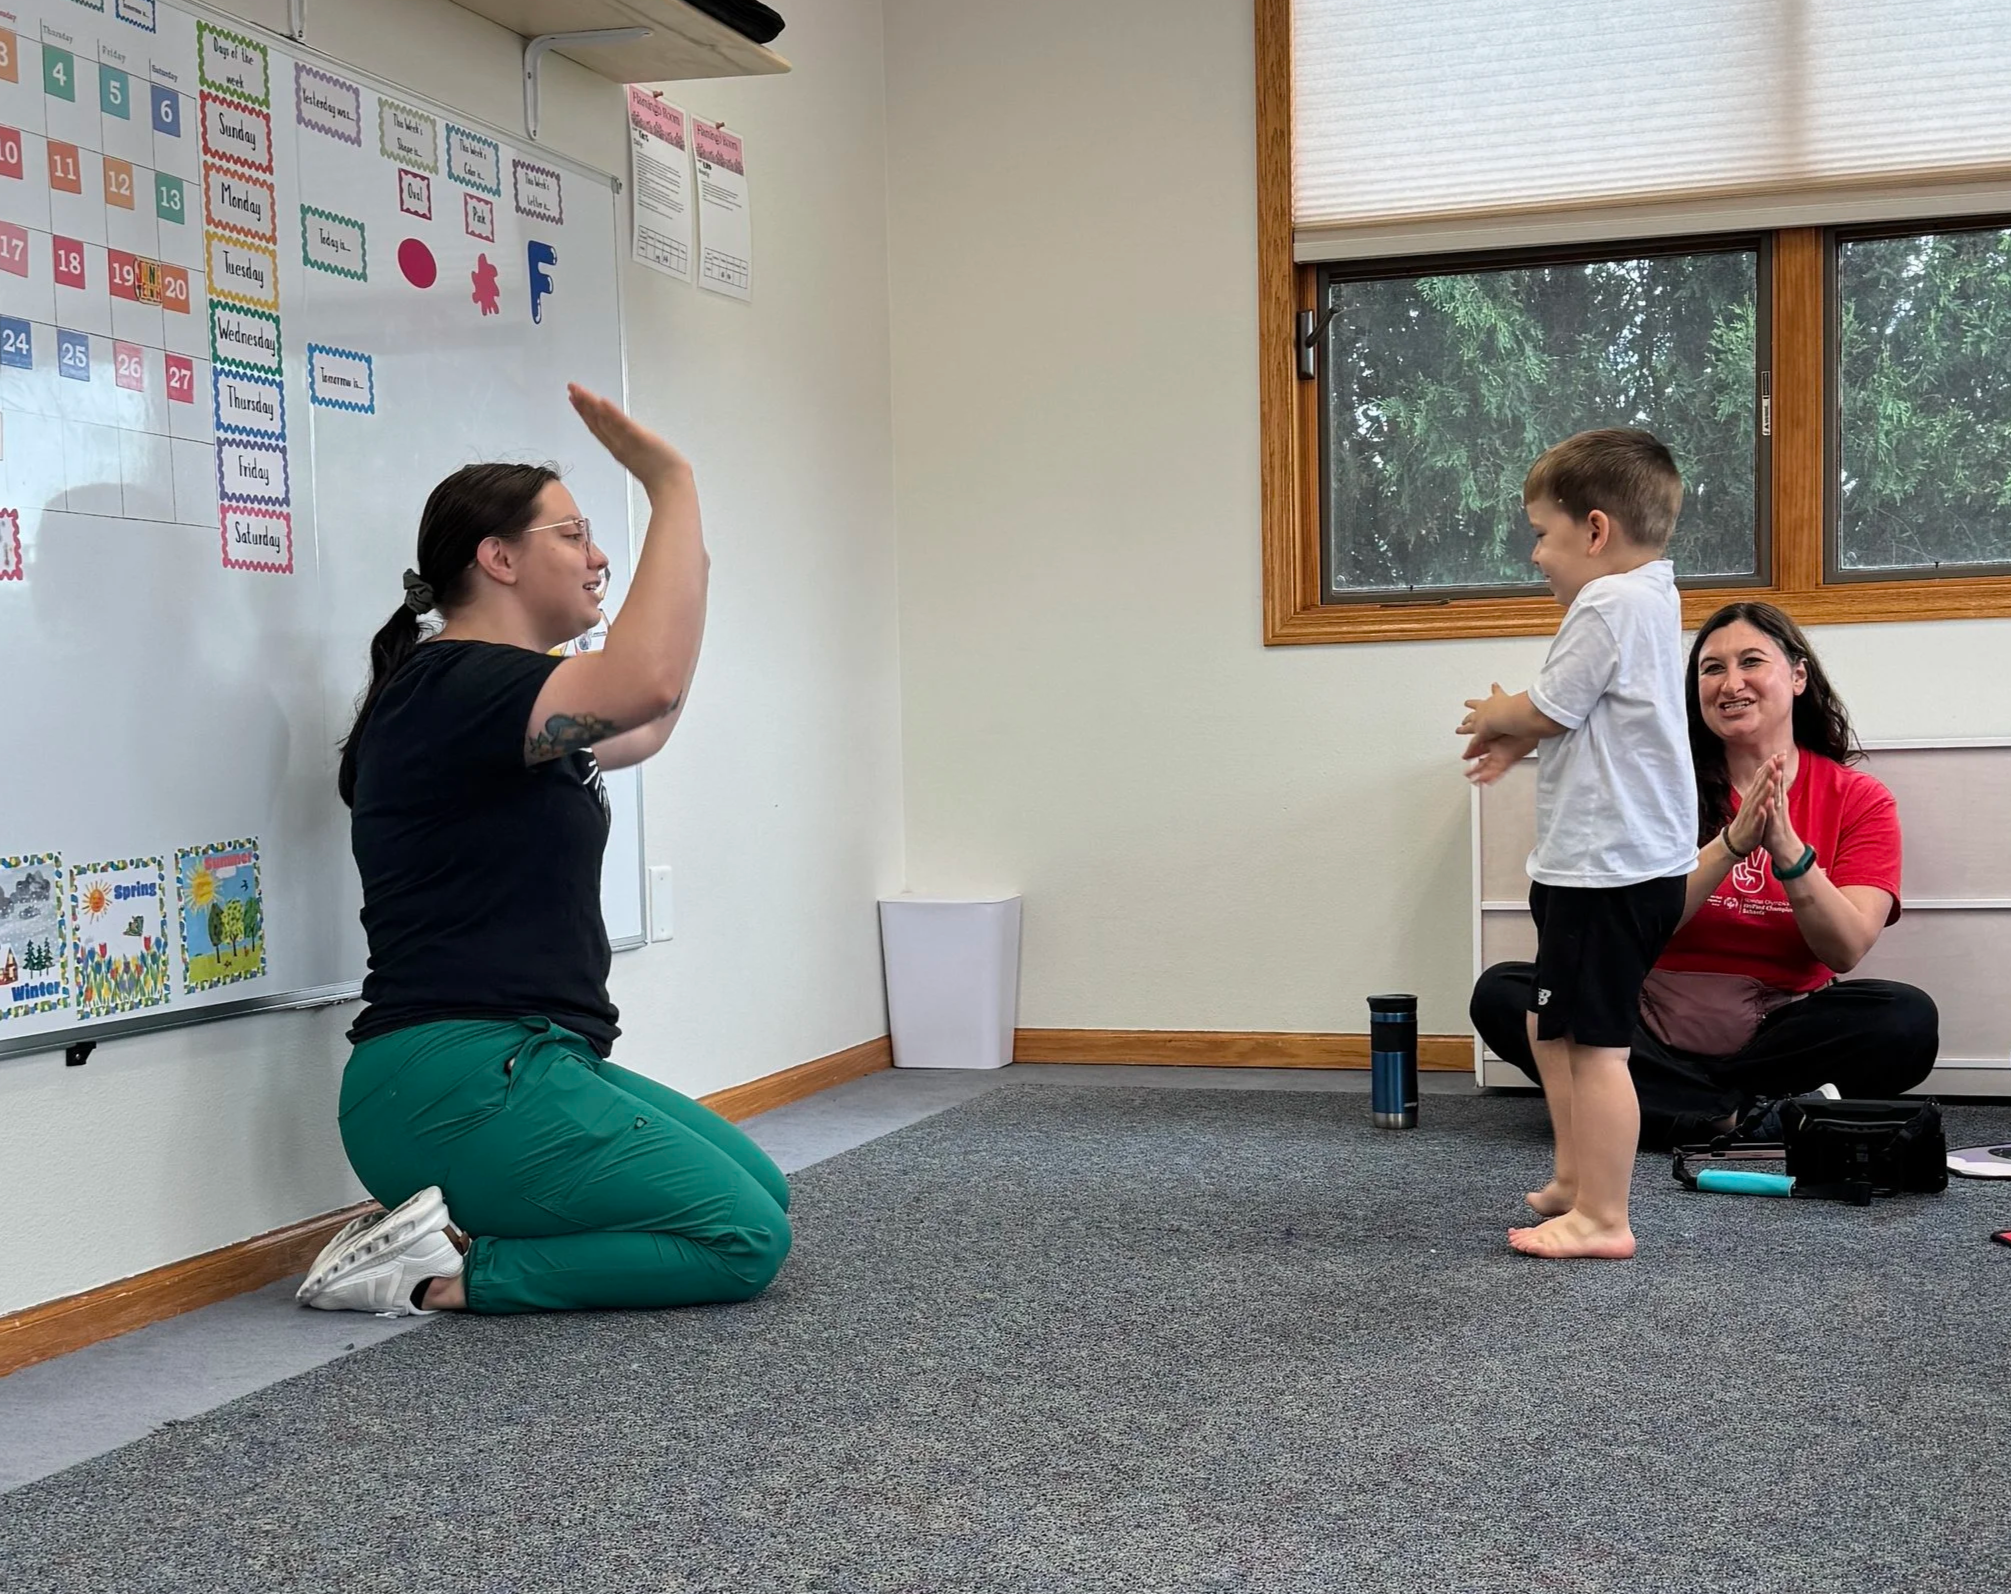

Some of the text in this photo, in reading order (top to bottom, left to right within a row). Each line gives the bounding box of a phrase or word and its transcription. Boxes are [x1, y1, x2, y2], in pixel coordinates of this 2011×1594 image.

[42, 24, 73, 45] Thursday
[102, 45, 126, 64] Friday
[213, 36, 254, 66] Days of the
[52, 62, 67, 87] 4
[151, 64, 179, 83] Saturday
[226, 74, 245, 89] week
[109, 80, 122, 105] 5
[302, 87, 336, 119] Yesterday
[160, 99, 173, 123] 6
[218, 112, 256, 151] Sunday
[53, 155, 77, 180] 11
[108, 171, 131, 196] 12
[407, 182, 424, 203] Oval
[159, 186, 181, 210] 13
[221, 181, 261, 222] Monday
[472, 205, 487, 226] Pink
[0, 235, 24, 261] 17
[318, 227, 339, 254] Today
[57, 249, 81, 275] 18
[112, 262, 135, 287] 19
[222, 249, 264, 289] Tuesday
[164, 276, 187, 300] 20
[527, 239, 558, 325] F
[2, 329, 30, 355] 24
[217, 316, 276, 357] Wednesday
[62, 342, 87, 368] 25
[118, 354, 142, 378] 26
[169, 366, 192, 390] 27
[320, 366, 351, 387] Tomorrow
[226, 384, 274, 421] Thursday
[238, 454, 270, 486] Friday
[234, 520, 281, 554] Saturday
[204, 851, 253, 870] Summer
[114, 881, 157, 900] Spring
[11, 980, 61, 1002] Winter
